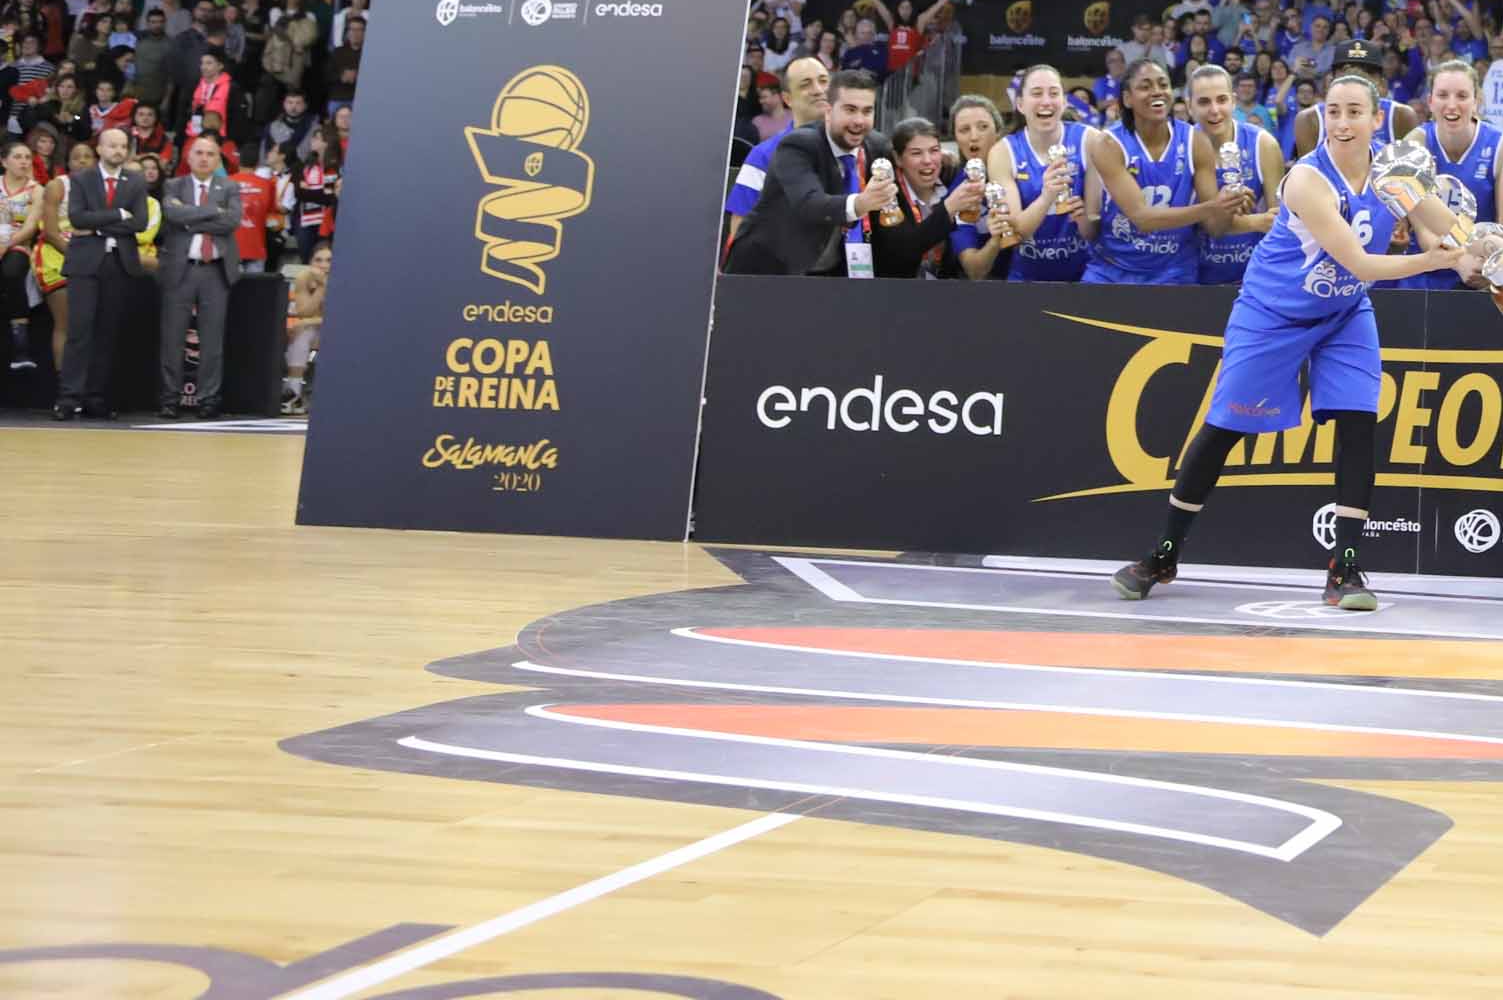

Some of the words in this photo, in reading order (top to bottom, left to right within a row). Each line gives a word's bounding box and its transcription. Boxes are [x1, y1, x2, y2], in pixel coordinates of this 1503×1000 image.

[595, 0, 663, 16] endesa
[1351, 209, 1373, 247] 6
[462, 300, 553, 323] endesa
[446, 338, 554, 376] COPA
[435, 376, 455, 390] DE
[457, 376, 560, 410] REINA
[433, 391, 454, 407] LA
[756, 375, 1004, 435] endesa
[492, 472, 541, 491] 2020
[1363, 517, 1421, 532] loncesto
